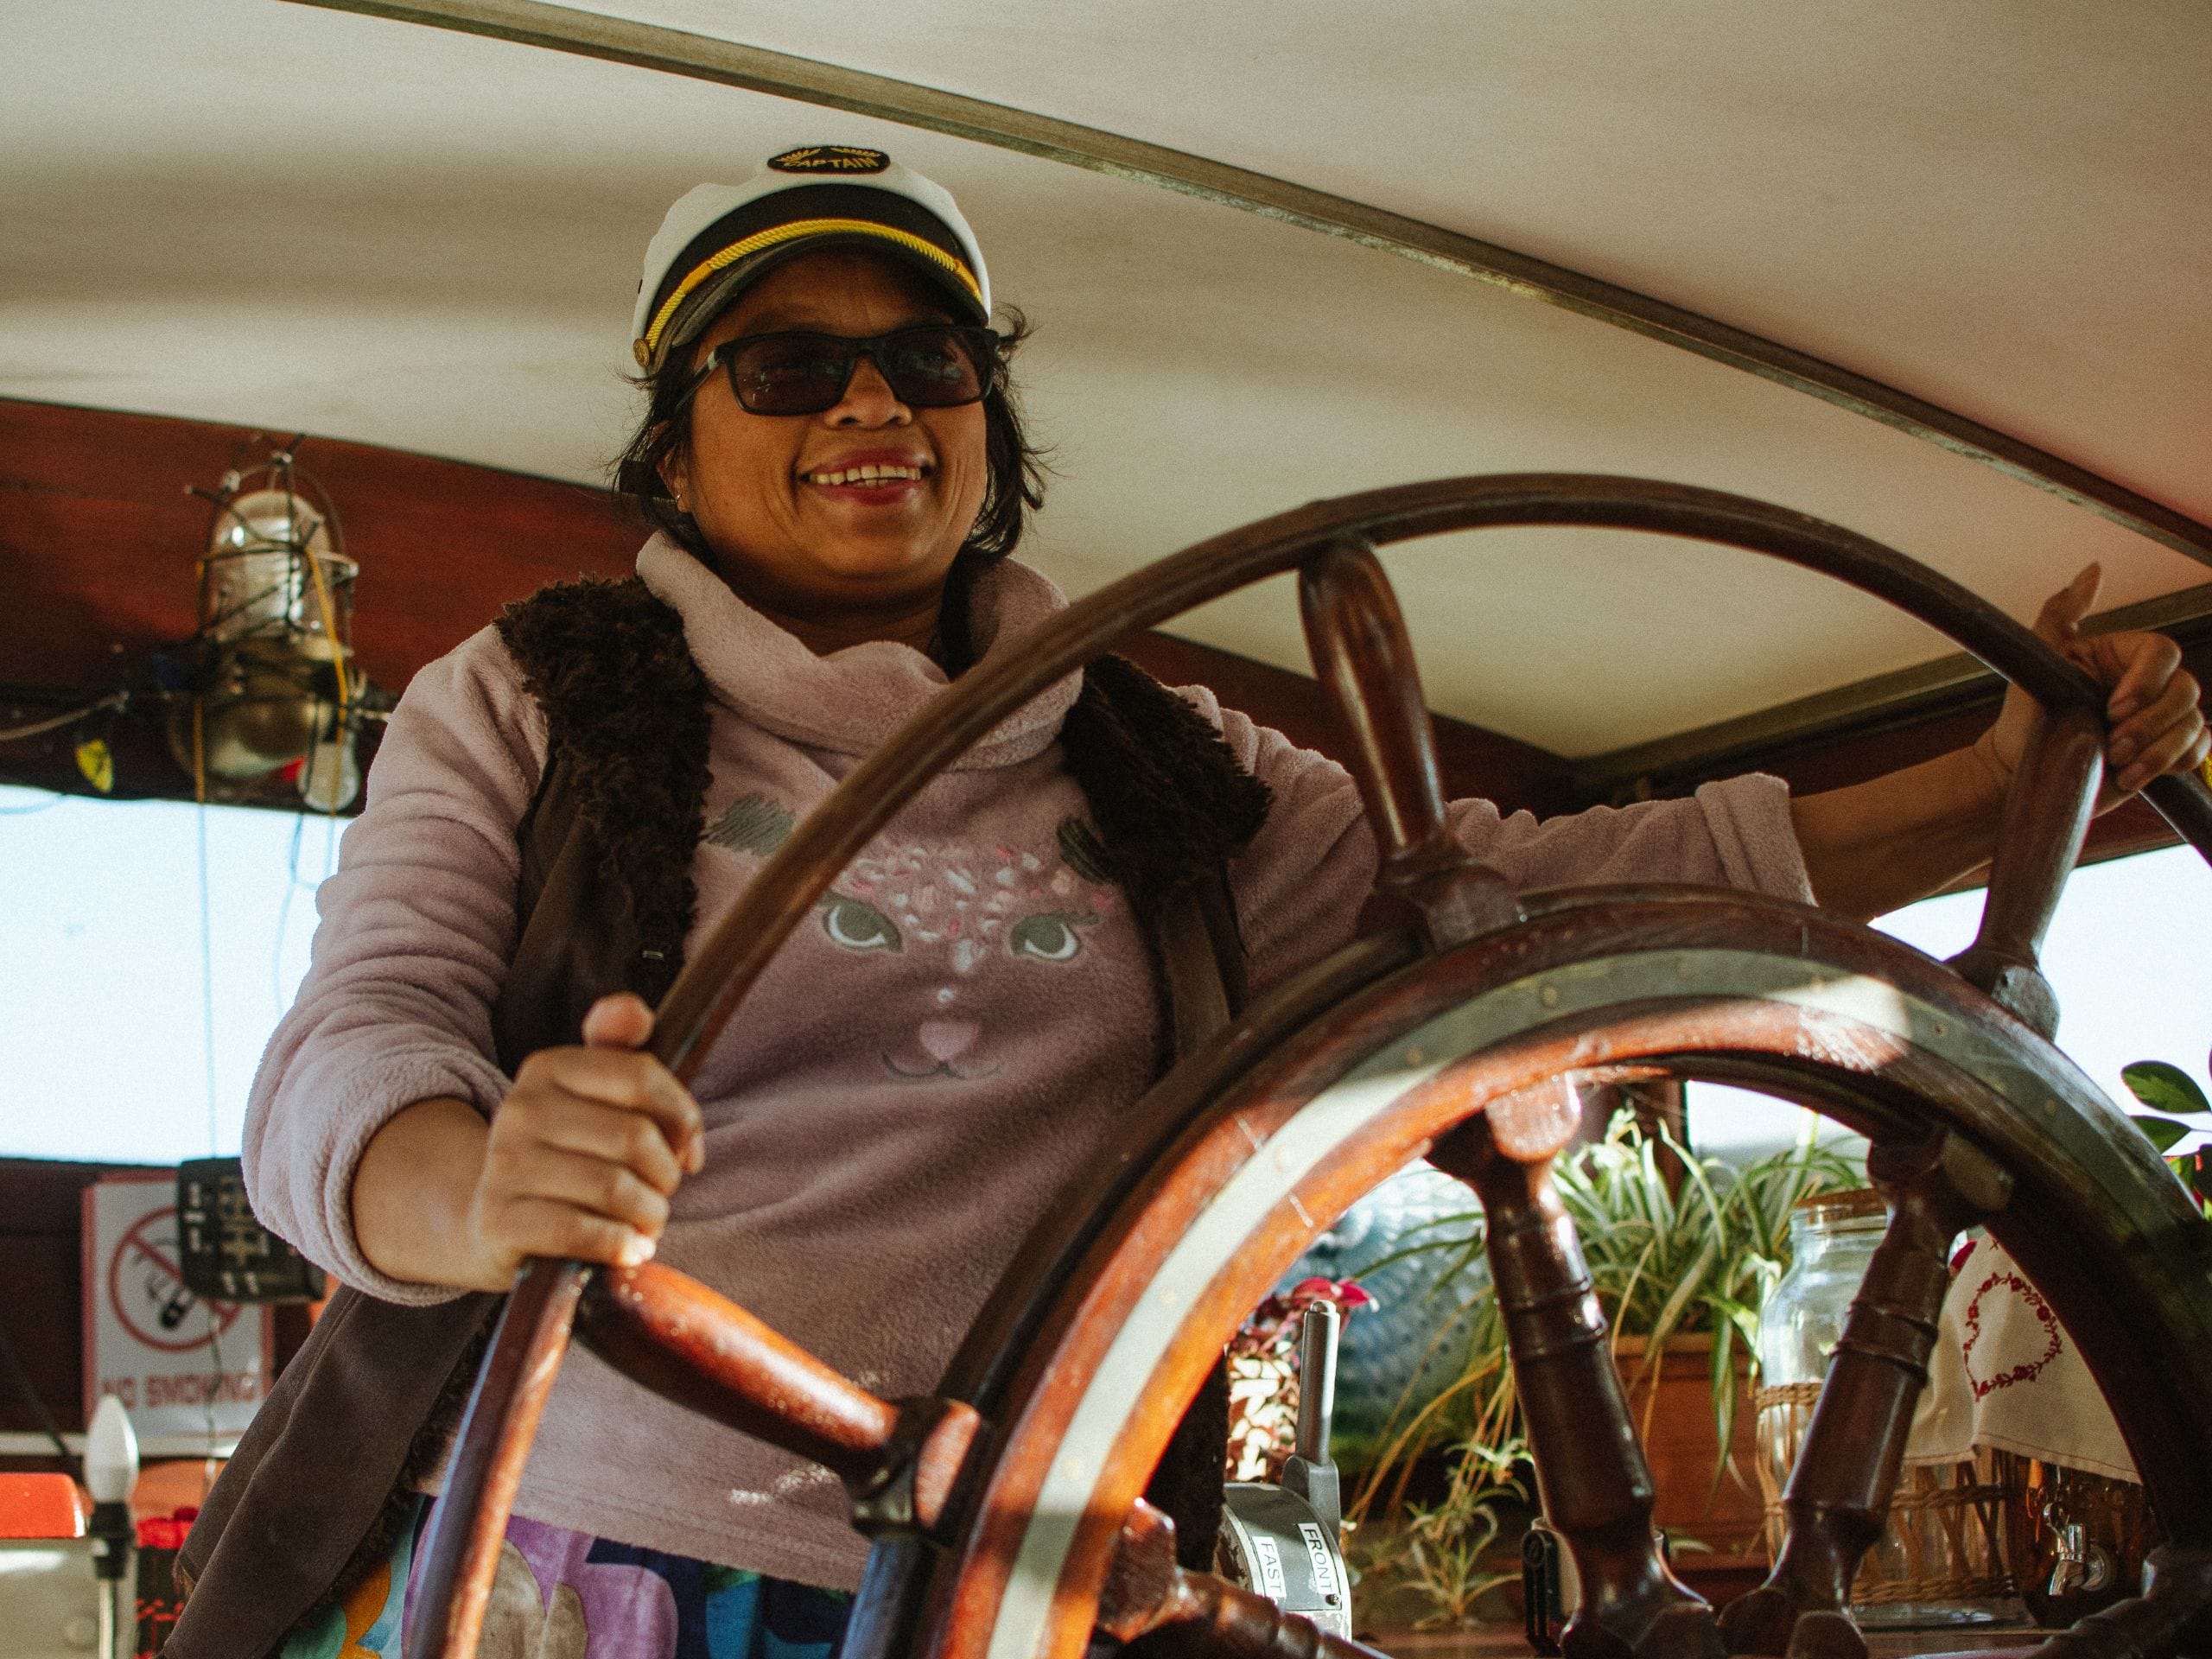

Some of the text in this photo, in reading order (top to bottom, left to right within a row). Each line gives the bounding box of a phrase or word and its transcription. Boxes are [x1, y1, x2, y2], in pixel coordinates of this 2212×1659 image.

[782, 157, 880, 168] CAPTAIN
[1262, 1543, 1282, 1592] FAST
[1304, 1529, 1333, 1592] FRONT
